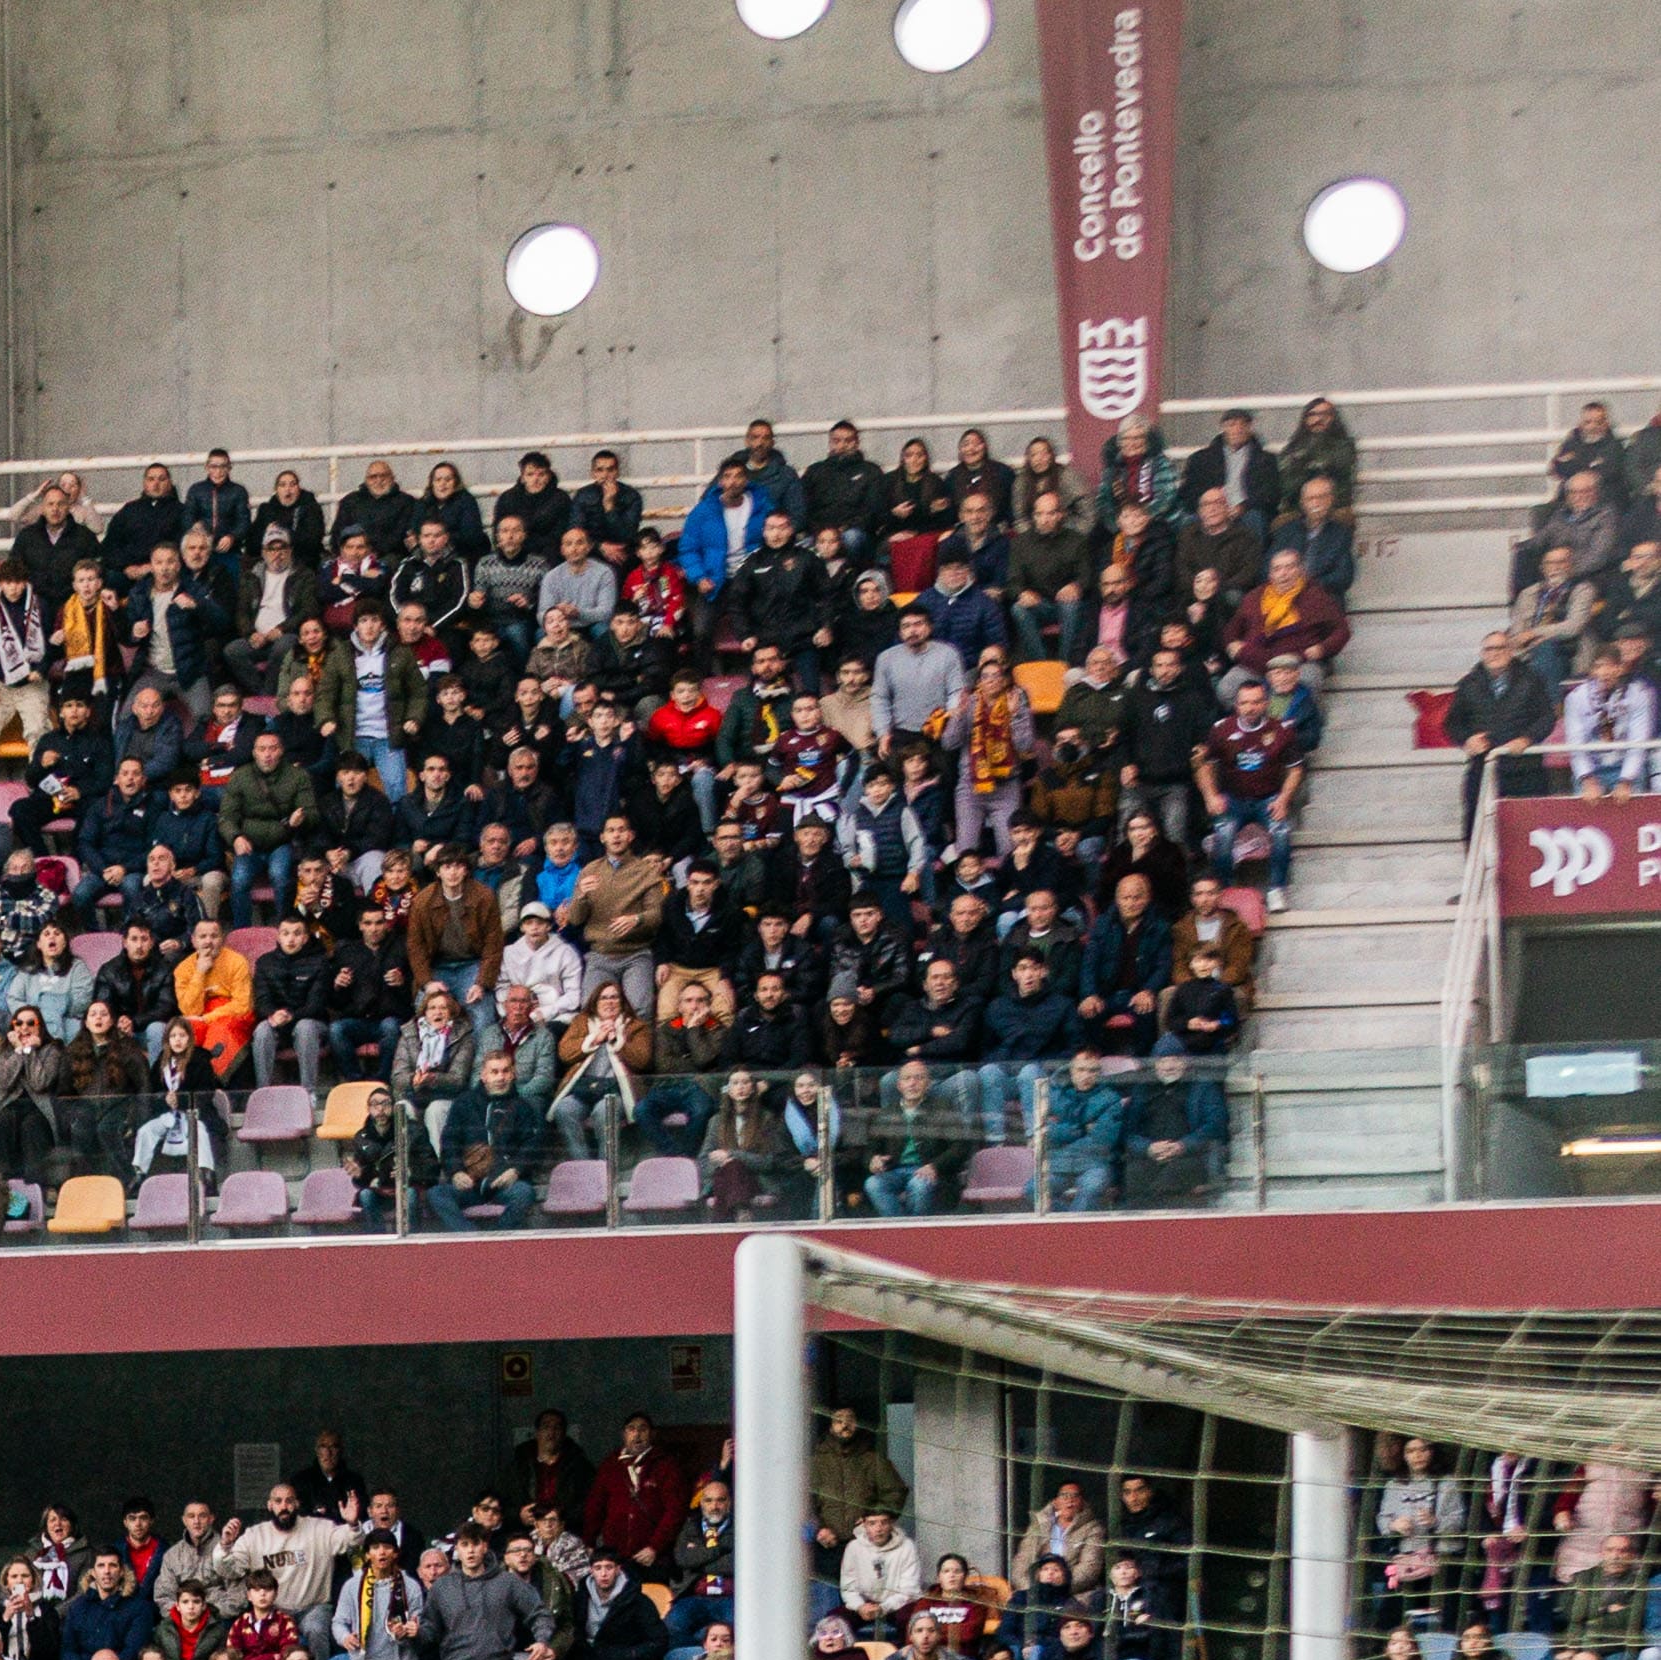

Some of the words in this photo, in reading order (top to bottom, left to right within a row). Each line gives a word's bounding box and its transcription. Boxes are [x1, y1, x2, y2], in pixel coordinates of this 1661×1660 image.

[1108, 7, 1144, 208] Pontevedra
[1072, 110, 1106, 262] Concello
[1109, 212, 1144, 260] de
